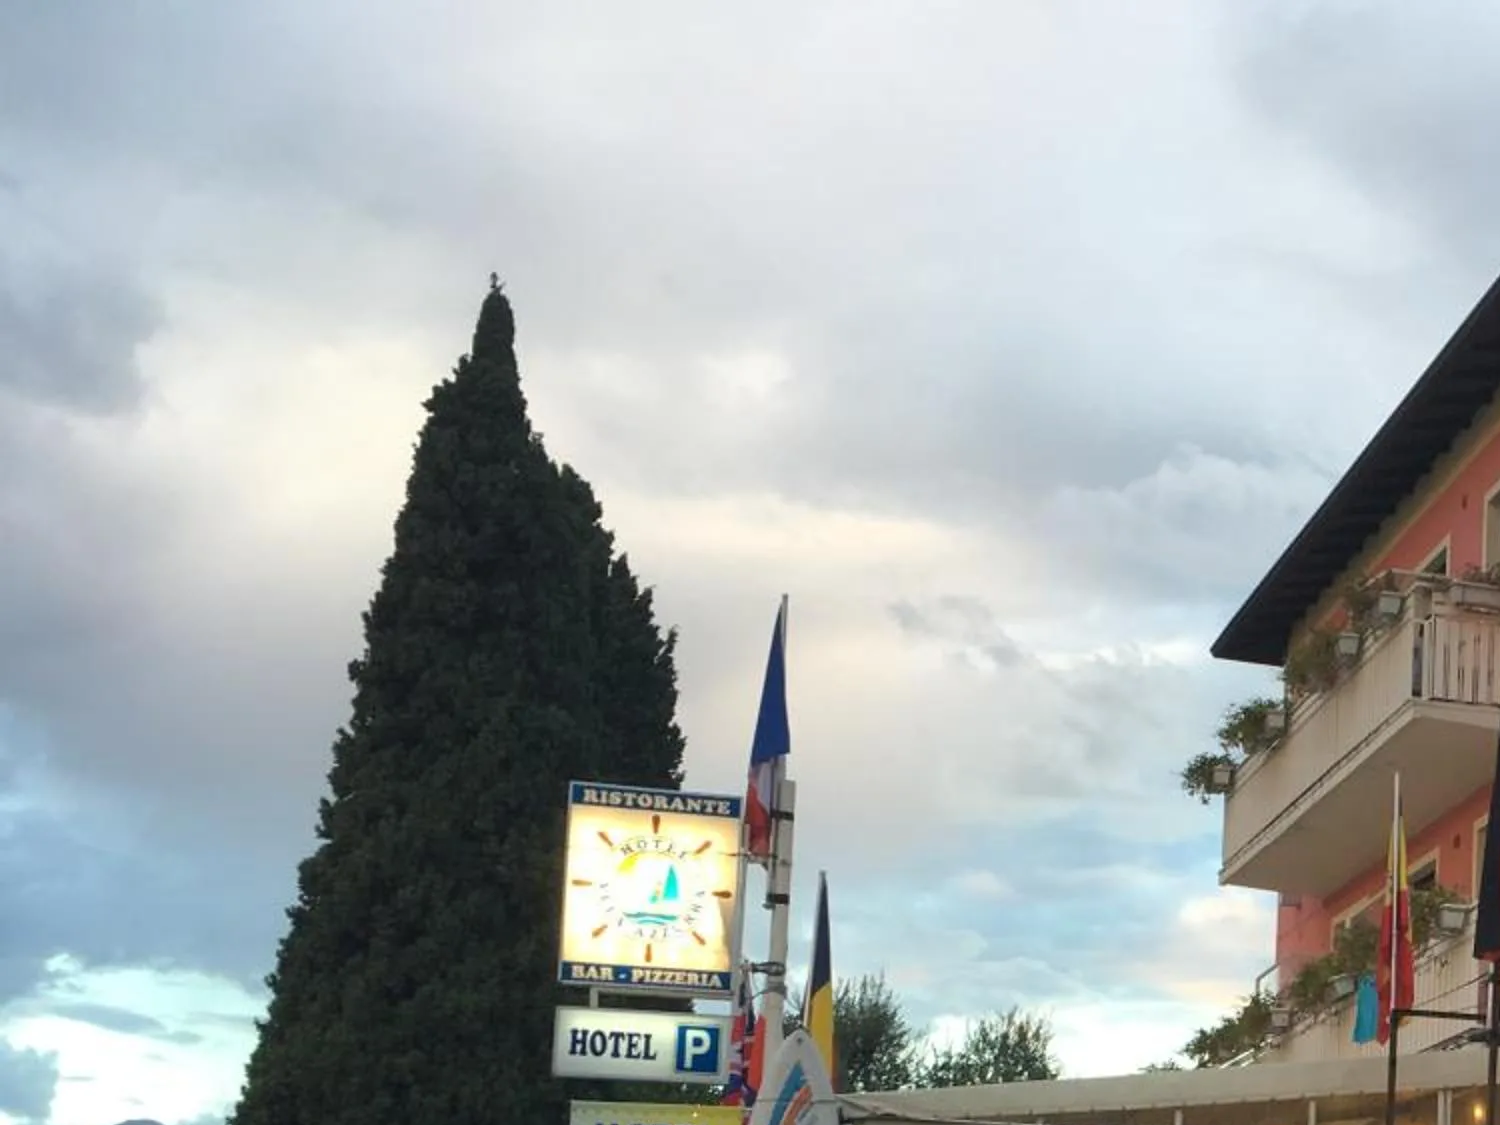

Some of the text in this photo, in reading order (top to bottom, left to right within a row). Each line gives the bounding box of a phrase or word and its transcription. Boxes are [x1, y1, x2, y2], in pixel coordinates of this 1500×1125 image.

[583, 788, 731, 815] RISTORANTE
[571, 965, 613, 981] BAR
[631, 968, 722, 988] PIZZERIA
[569, 1028, 657, 1061] HOTEL
